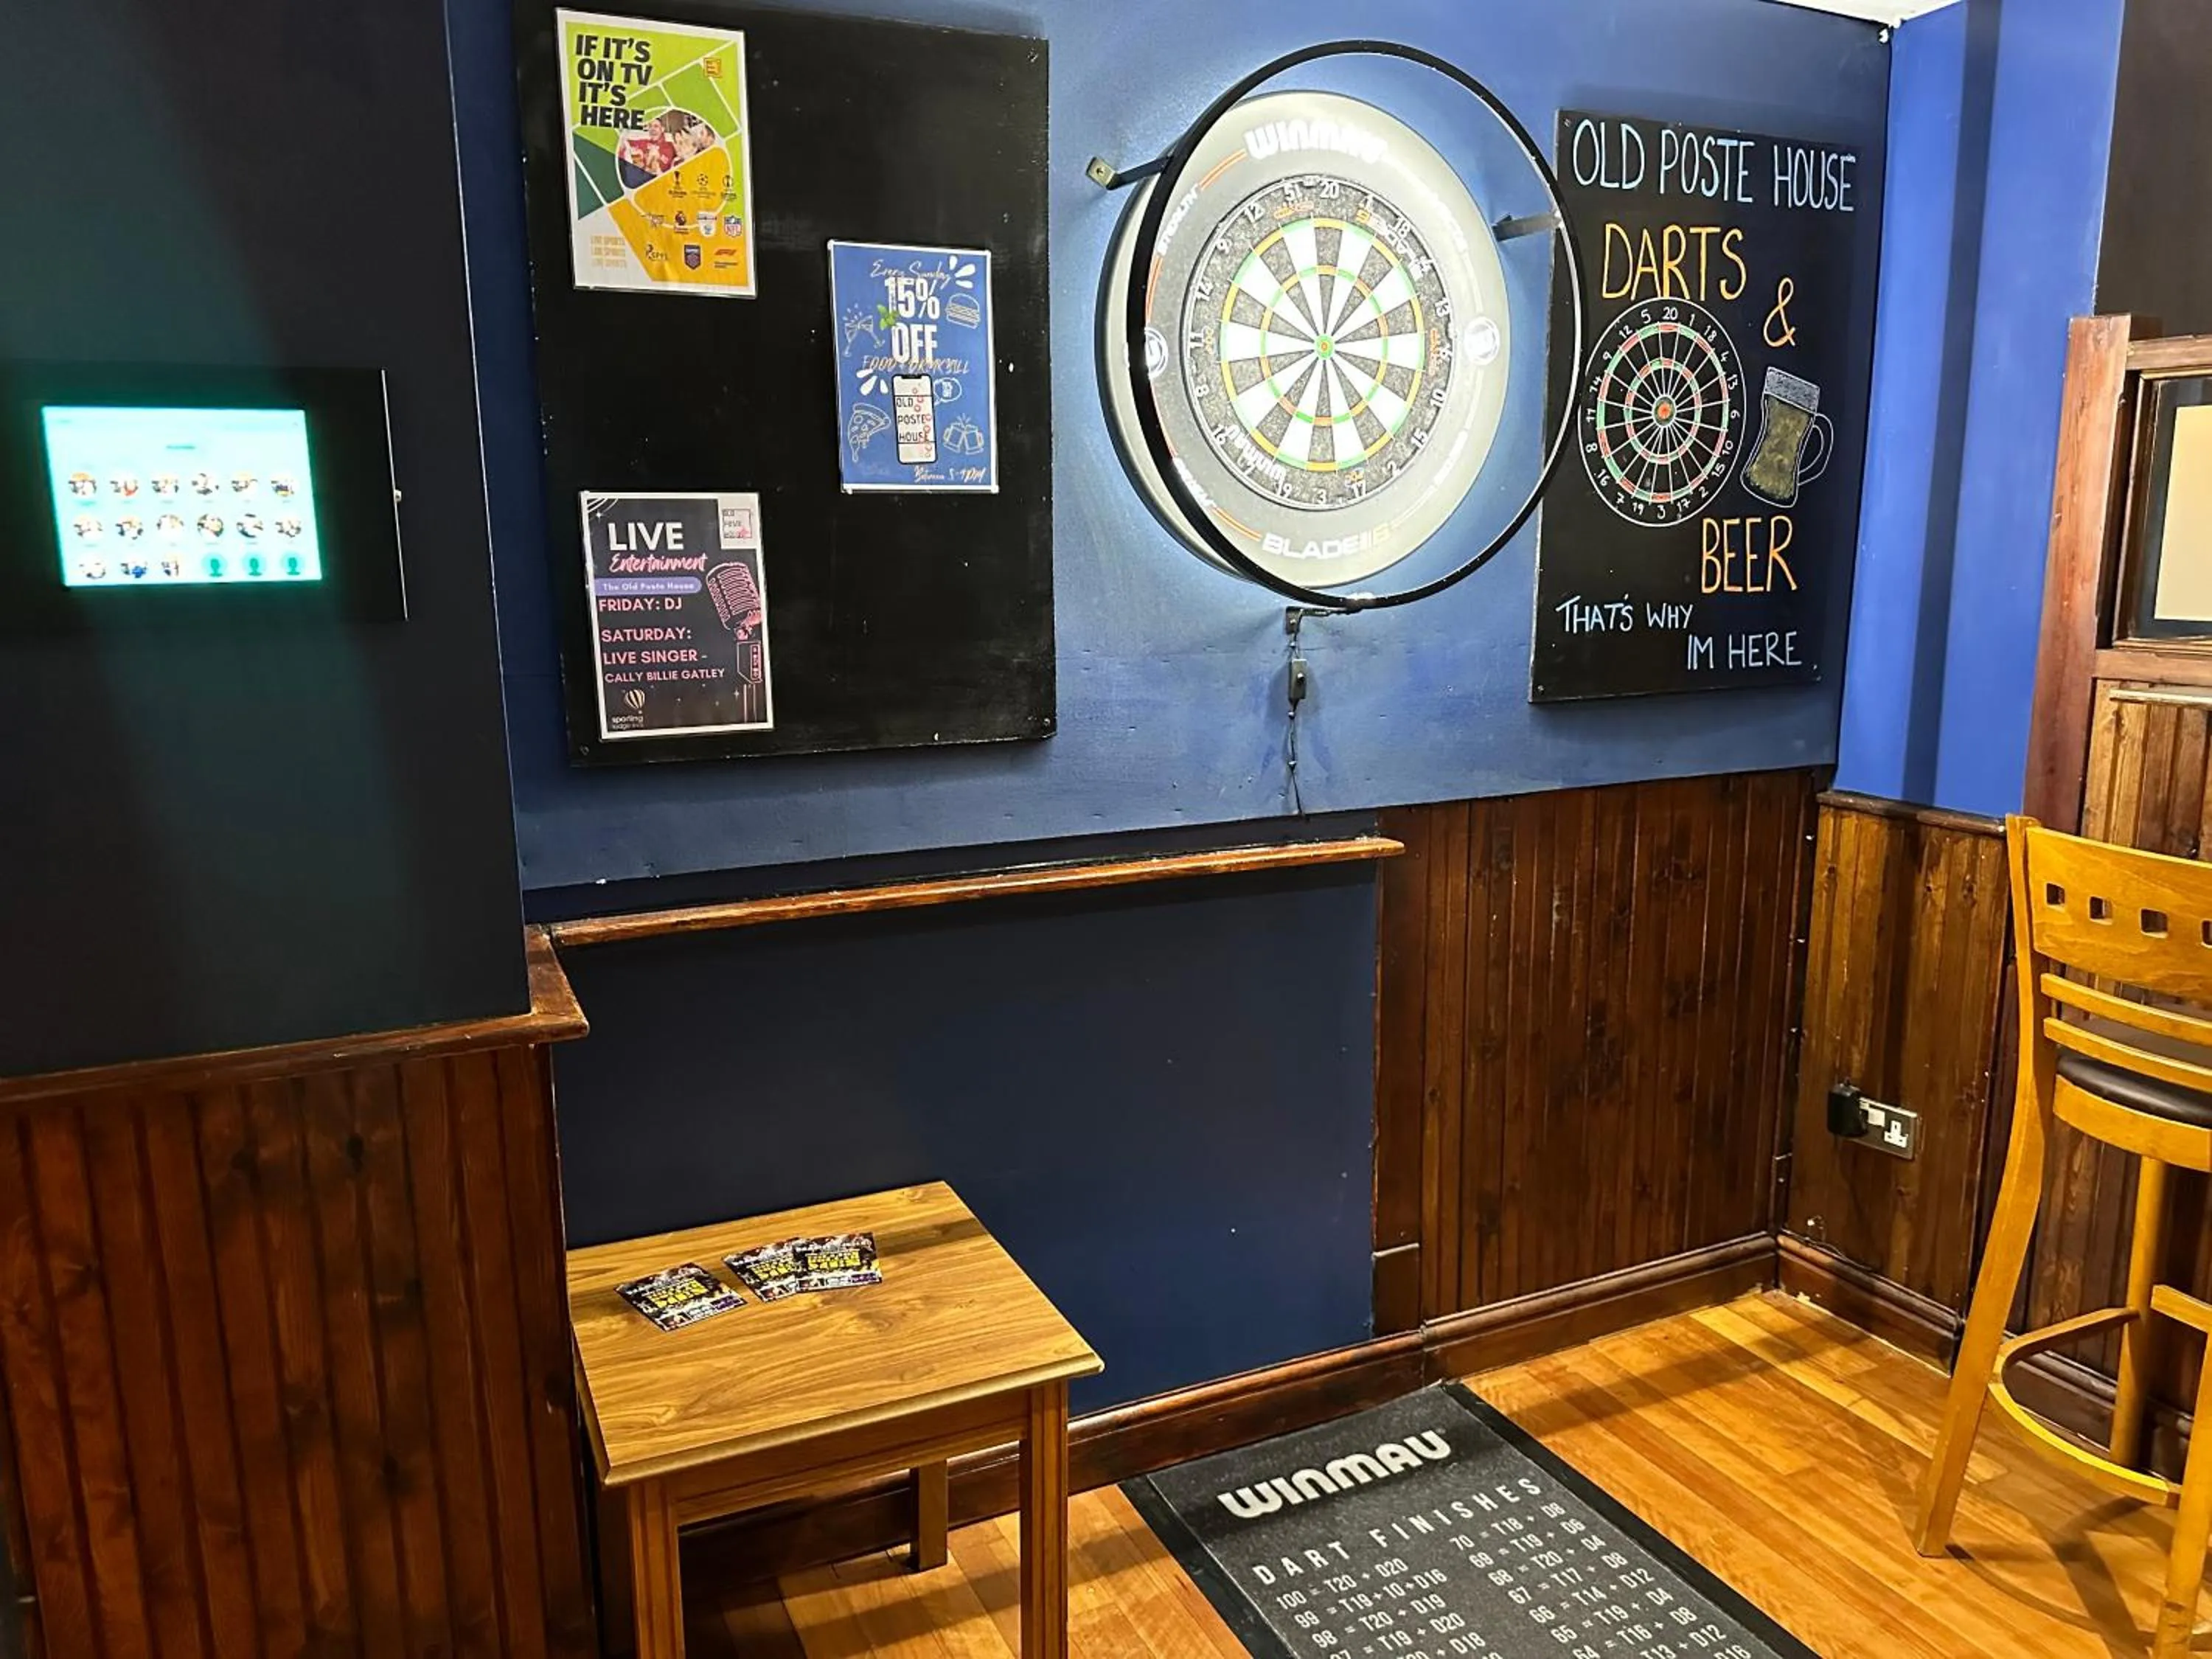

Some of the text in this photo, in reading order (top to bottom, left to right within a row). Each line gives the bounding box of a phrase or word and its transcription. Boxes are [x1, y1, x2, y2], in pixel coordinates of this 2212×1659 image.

[575, 35, 650, 63] IF IT'S
[577, 58, 653, 86] ON TV
[579, 82, 626, 106] IT'S
[1243, 119, 1388, 164] WINMAU
[1573, 119, 1856, 212] OLD POSTE HOUSE
[1319, 180, 1340, 199] 20
[1244, 204, 1266, 223] 12
[1388, 218, 1411, 238] 18
[1217, 237, 1233, 255] 9
[1602, 223, 1747, 302] DARTS
[909, 260, 951, 290] Sunday
[885, 277, 940, 319] 15%
[1197, 279, 1214, 302] 14
[1641, 309, 1651, 323] 5
[1662, 307, 1678, 320] 20
[1688, 314, 1695, 326] 1
[1764, 277, 1796, 348] &
[1190, 333, 1204, 348] 11
[1618, 325, 1632, 339] 12
[1703, 325, 1717, 341] 18
[891, 322, 938, 364] OFF
[863, 355, 897, 372] FOOD
[1602, 351, 1612, 361] 9
[1720, 350, 1729, 362] 4
[1194, 383, 1210, 397] 8
[1589, 375, 1603, 393] 14
[1727, 374, 1739, 389] 13
[896, 398, 914, 408] OLD
[1430, 389, 1446, 407] 10
[897, 414, 927, 425] POSTE
[1586, 408, 1596, 422] 11
[899, 432, 930, 442] HOUSE
[1214, 425, 1227, 445] 16
[1411, 428, 1428, 447] 15
[1585, 443, 1598, 453] 8
[1722, 441, 1733, 455] 10
[1386, 461, 1402, 476] 2
[1598, 469, 1610, 486] 16
[1711, 463, 1726, 478] 15
[1276, 479, 1293, 499] 19
[1316, 490, 1327, 504] 3
[1616, 492, 1624, 504] 7
[1699, 487, 1708, 498] 2
[1632, 502, 1644, 515] 19
[1658, 505, 1666, 519] 3
[1677, 498, 1691, 512] 17
[608, 522, 684, 550] LIVE
[1262, 532, 1360, 560] BLADE
[1702, 515, 1797, 594] BEER
[609, 552, 708, 573] Entertainment
[599, 597, 683, 612] FRIDAY: DJ
[1556, 594, 1693, 633] THAT'S WHY
[602, 627, 692, 643] SATURDAY:
[603, 652, 637, 665] LIVE
[641, 650, 698, 664] SINGER
[1688, 635, 1714, 670] IM
[605, 667, 726, 684] CALLY BILLIE GATLEY
[1217, 1430, 1451, 1518] WINMAU
[1252, 1478, 1541, 1585] DART FINISHES
[1449, 1534, 1475, 1551] 70
[1490, 1517, 1524, 1536] T18
[1540, 1502, 1566, 1519] D8
[1468, 1551, 1495, 1568] 69
[1509, 1533, 1544, 1553] T19
[1559, 1518, 1586, 1534] D6
[1487, 1568, 1514, 1586] 68
[1529, 1550, 1564, 1570] T20
[1580, 1534, 1607, 1552] D4
[1276, 1590, 1307, 1610] 100
[1323, 1574, 1357, 1593] T20
[1374, 1557, 1409, 1578] D20
[1507, 1585, 1532, 1604] 67
[1549, 1567, 1584, 1587] T17
[1601, 1551, 1629, 1569] D8
[1528, 1604, 1557, 1624] 66
[1571, 1585, 1607, 1607] T14
[1618, 1568, 1655, 1589] D12
[1294, 1610, 1321, 1629] 99
[1312, 1630, 1338, 1648] 98
[1357, 1611, 1394, 1632] T20
[1410, 1593, 1447, 1615] D19
[1550, 1624, 1578, 1644] 65
[1593, 1604, 1630, 1625] T19
[1645, 1587, 1674, 1606] D4
[1377, 1630, 1413, 1651] T19
[1429, 1613, 1466, 1634] D20
[1572, 1644, 1601, 1659] 64
[1615, 1624, 1653, 1646] T16
[1669, 1606, 1698, 1626] D8
[1688, 1624, 1727, 1648] D12
[1449, 1632, 1486, 1655] D18
